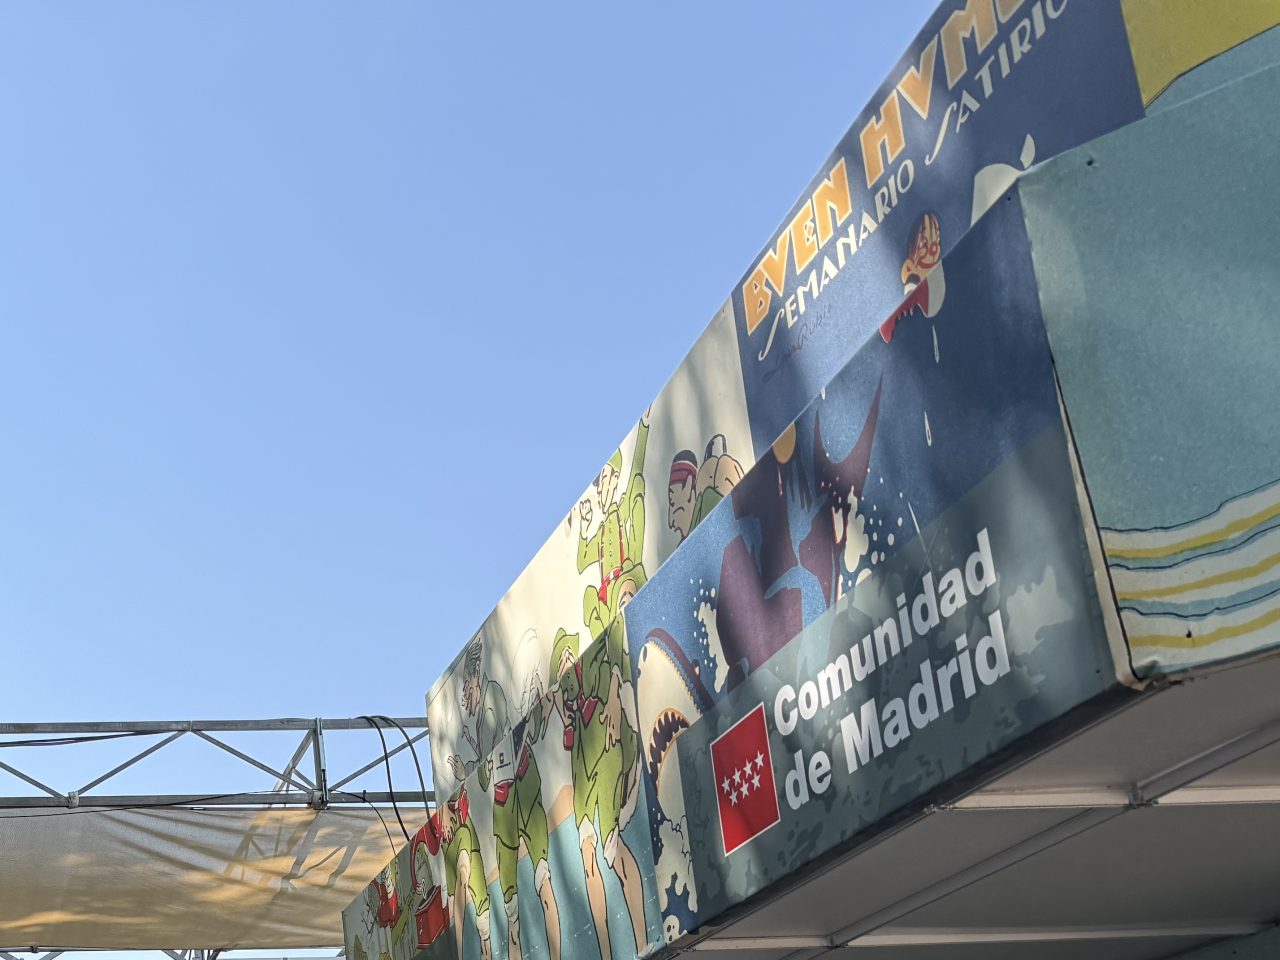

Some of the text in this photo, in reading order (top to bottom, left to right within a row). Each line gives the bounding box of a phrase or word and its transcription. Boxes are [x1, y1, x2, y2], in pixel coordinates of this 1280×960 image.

[742, 157, 852, 336] BVEN
[758, 158, 914, 361] SEMANARIO
[774, 526, 997, 736] Comunidad
[785, 609, 1011, 810] de Madrid
